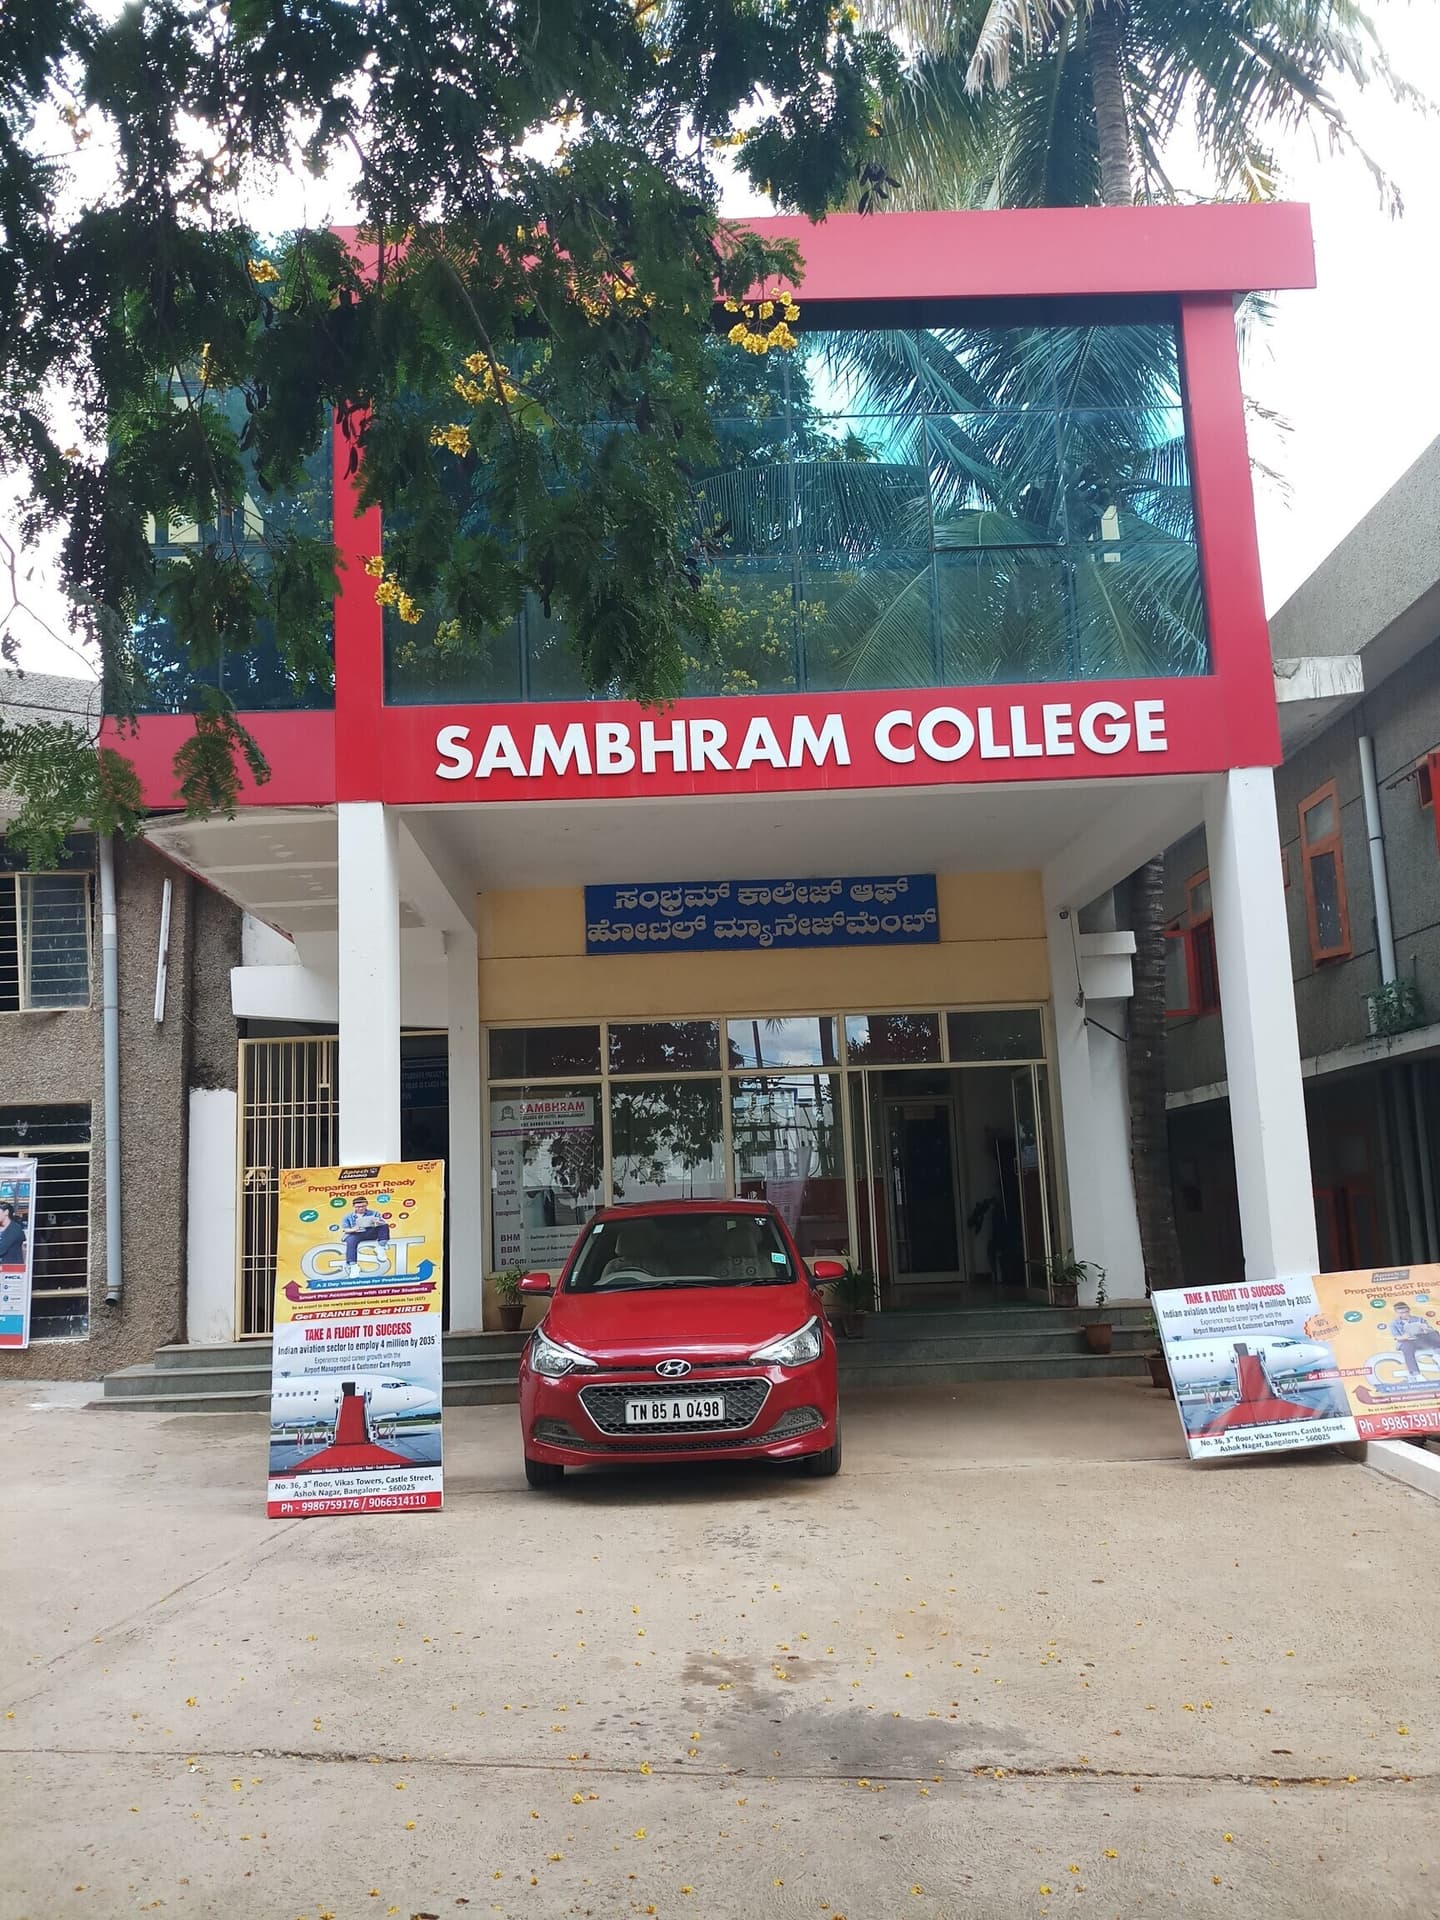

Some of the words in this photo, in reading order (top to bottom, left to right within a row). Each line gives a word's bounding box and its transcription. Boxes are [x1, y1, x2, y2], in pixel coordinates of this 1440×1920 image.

[435, 713, 852, 780] SAMBHRAM
[874, 699, 1169, 763] COLLEGE
[614, 882, 730, 917] ಸಂಭ್ರಮ್
[737, 879, 842, 906] ಕಾಲೇಜ್
[850, 877, 909, 905] ಆಫ್
[520, 1101, 585, 1114] SAMBHRAM
[308, 1182, 357, 1193] Preparing
[360, 1181, 381, 1189] GST
[383, 1179, 416, 1188] Ready
[329, 1187, 395, 1199] Professionals
[500, 1233, 521, 1242] BHM
[301, 1236, 426, 1281] GST
[1184, 1292, 1204, 1305] TAKE
[1205, 1291, 1211, 1302] A
[1212, 1288, 1238, 1302] FLIGHT
[1240, 1287, 1250, 1299] TO
[1252, 1283, 1286, 1298] SUCCESS
[1344, 1285, 1393, 1294] Preparing
[1366, 1288, 1431, 1299] Professionals
[316, 1310, 359, 1319] TRAINED
[373, 1307, 392, 1315] Get
[393, 1305, 424, 1313] HIRED
[1162, 1310, 1182, 1318] Indian
[1184, 1307, 1208, 1317] aviation
[1236, 1302, 1258, 1312] employ
[305, 1328, 324, 1341] TAKE
[326, 1328, 331, 1340] A
[334, 1325, 361, 1339] FLIGHT
[363, 1325, 374, 1337] TO
[375, 1322, 412, 1336] SUCCESS
[278, 1346, 298, 1355] Indian
[299, 1344, 325, 1354] aviation
[326, 1342, 346, 1352] sector
[348, 1342, 354, 1351] to
[356, 1339, 379, 1352] employ
[380, 1339, 385, 1348] 4
[386, 1337, 409, 1348] million
[410, 1336, 418, 1348] by
[321, 1363, 351, 1373] Management
[391, 1360, 411, 1369] Program
[631, 1404, 647, 1421] TN
[652, 1403, 667, 1419] 85
[673, 1402, 680, 1418] A
[686, 1401, 719, 1418] 0498
[1359, 1420, 1374, 1433] Ph
[1381, 1411, 1440, 1431] 998675917
[1200, 1439, 1212, 1447] No.
[1255, 1432, 1273, 1440] Vikas
[1273, 1430, 1300, 1439] Towers,
[1301, 1427, 1321, 1435] Castle
[1322, 1424, 1346, 1433] Street,
[1220, 1444, 1240, 1452] Ashok
[1266, 1438, 1299, 1448] Bangalore
[313, 1479, 333, 1489] floor,
[334, 1478, 354, 1487] Vikas
[356, 1477, 384, 1486] Towers,
[386, 1475, 408, 1484] Castle
[410, 1474, 434, 1483] Street,
[293, 1489, 317, 1498] Ashok
[318, 1488, 341, 1498] Nagar,
[343, 1486, 381, 1497] Bangalore
[388, 1484, 416, 1493] 560025
[281, 1503, 293, 1513] Ph
[302, 1500, 359, 1511] 9986759176
[369, 1495, 426, 1508] 9066314110
